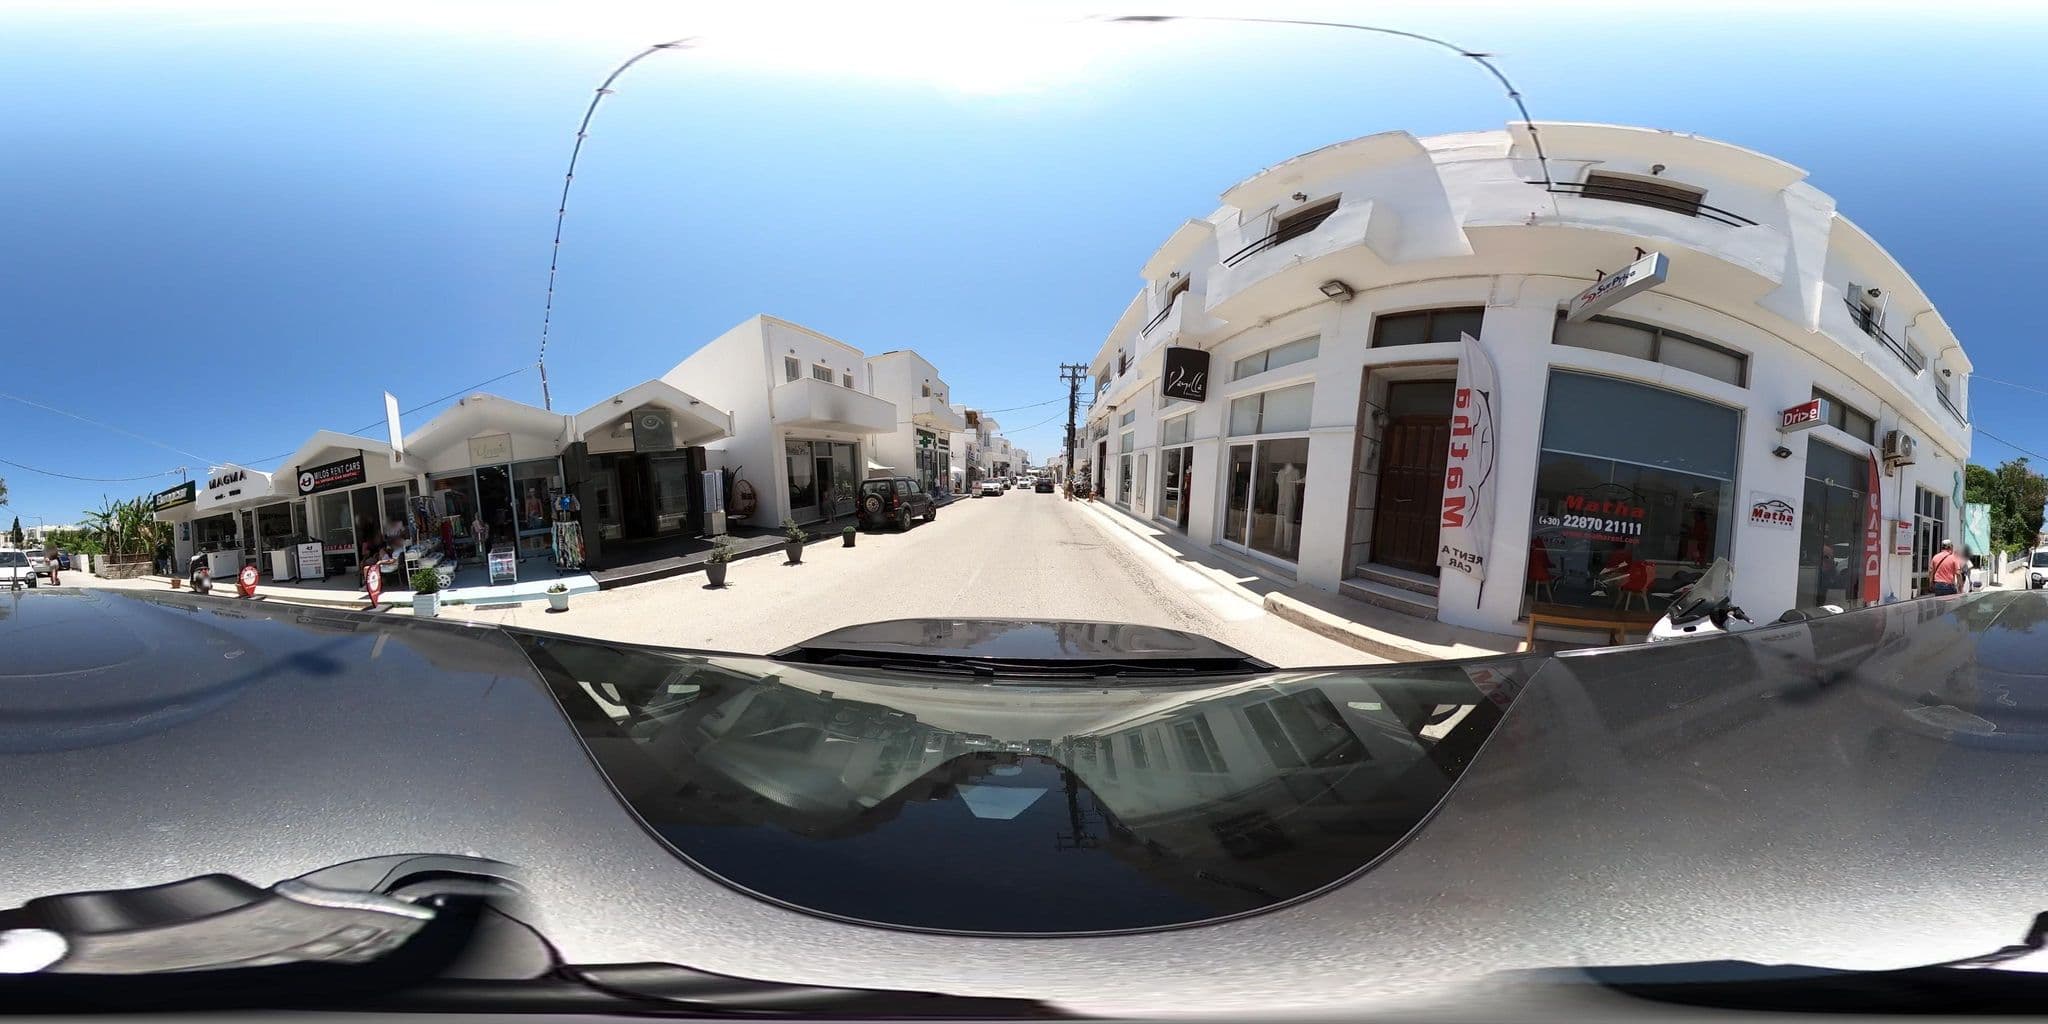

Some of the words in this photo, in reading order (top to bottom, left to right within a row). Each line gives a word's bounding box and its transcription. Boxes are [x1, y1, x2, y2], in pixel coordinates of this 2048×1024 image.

[345, 461, 361, 473] CARS
[208, 470, 247, 490] MAGMA
[1565, 495, 1646, 518] Matha
[1752, 508, 1793, 522] Matha
[1539, 516, 1560, 528] (+30)
[1562, 514, 1603, 531] 22870
[1604, 520, 1642, 536] 21111
